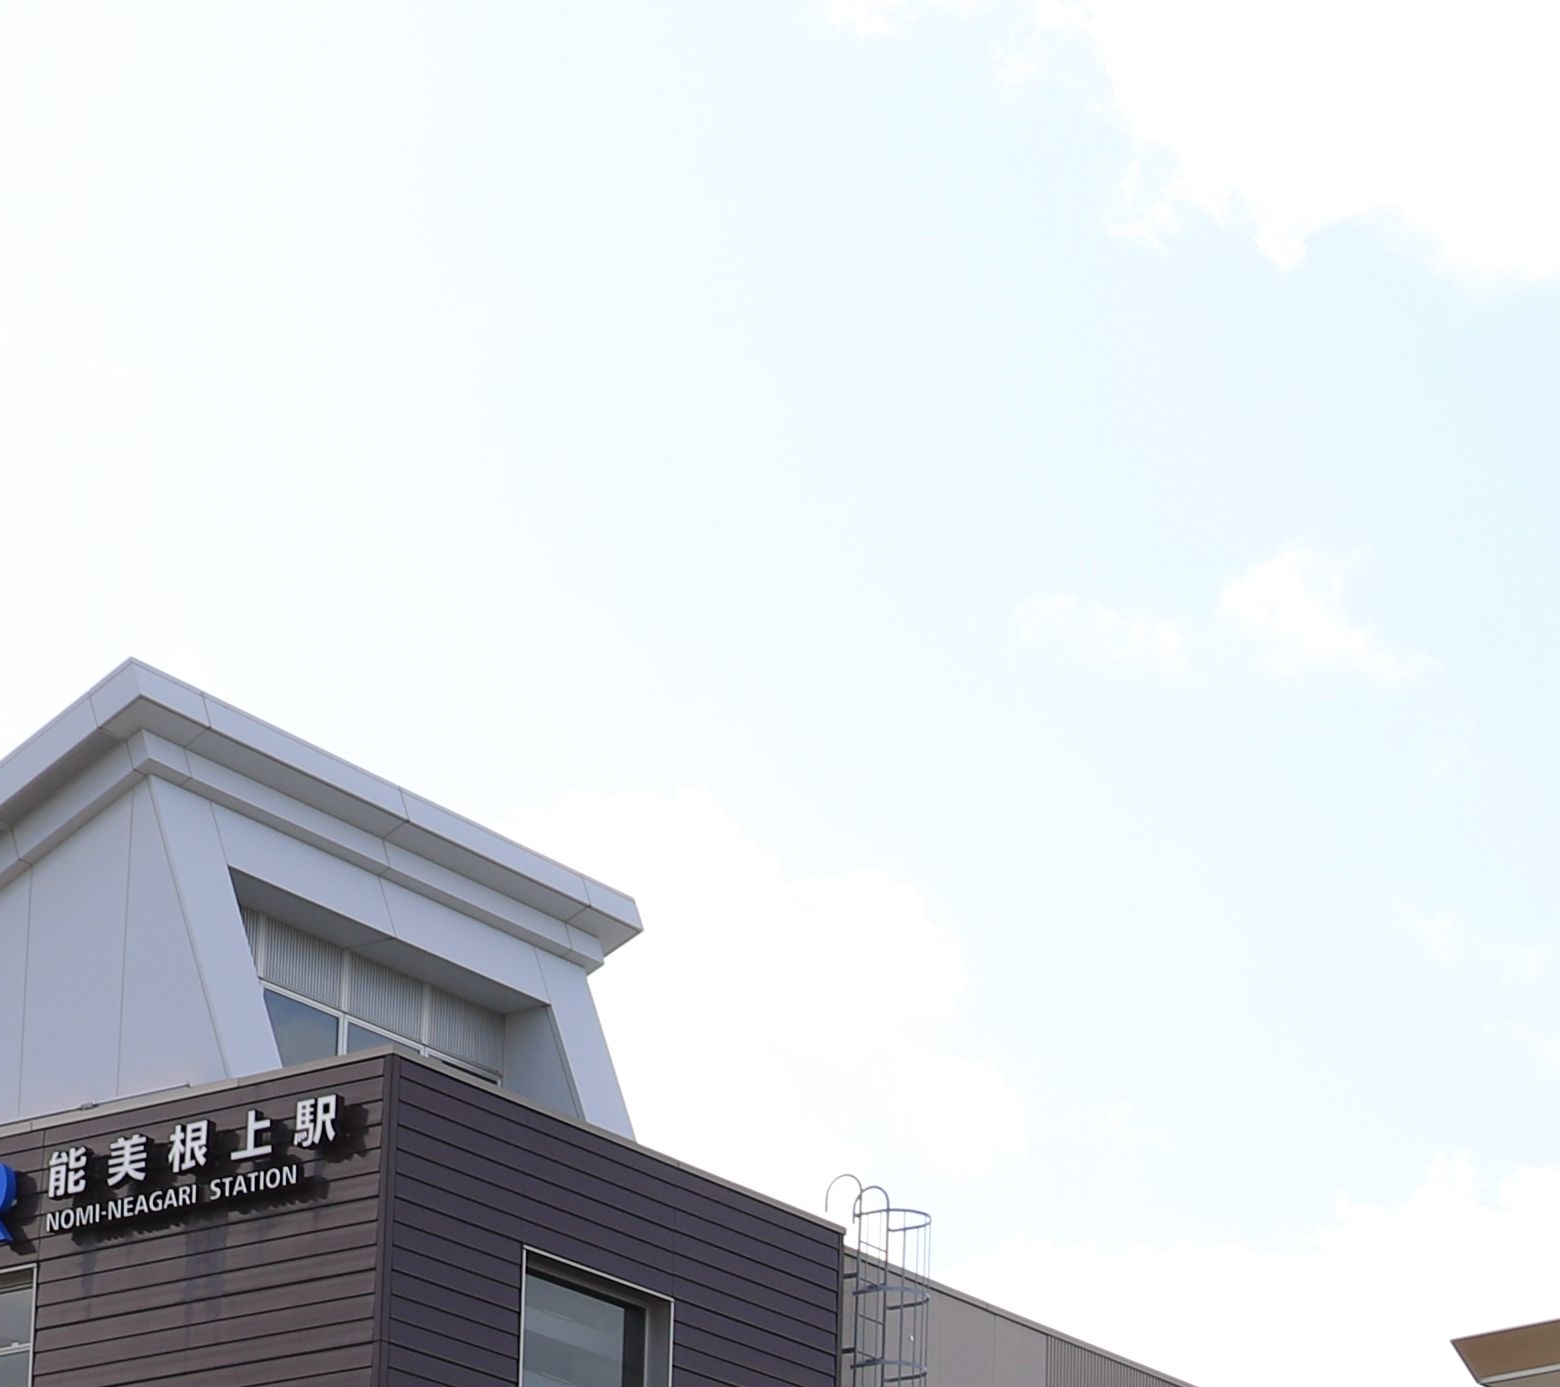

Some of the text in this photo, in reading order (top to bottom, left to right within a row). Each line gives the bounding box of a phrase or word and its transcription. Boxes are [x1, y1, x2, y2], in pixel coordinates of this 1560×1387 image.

[48, 1094, 338, 1198] 能美根上駅
[45, 1164, 298, 1233] NOMI-NEAGARI STATION
